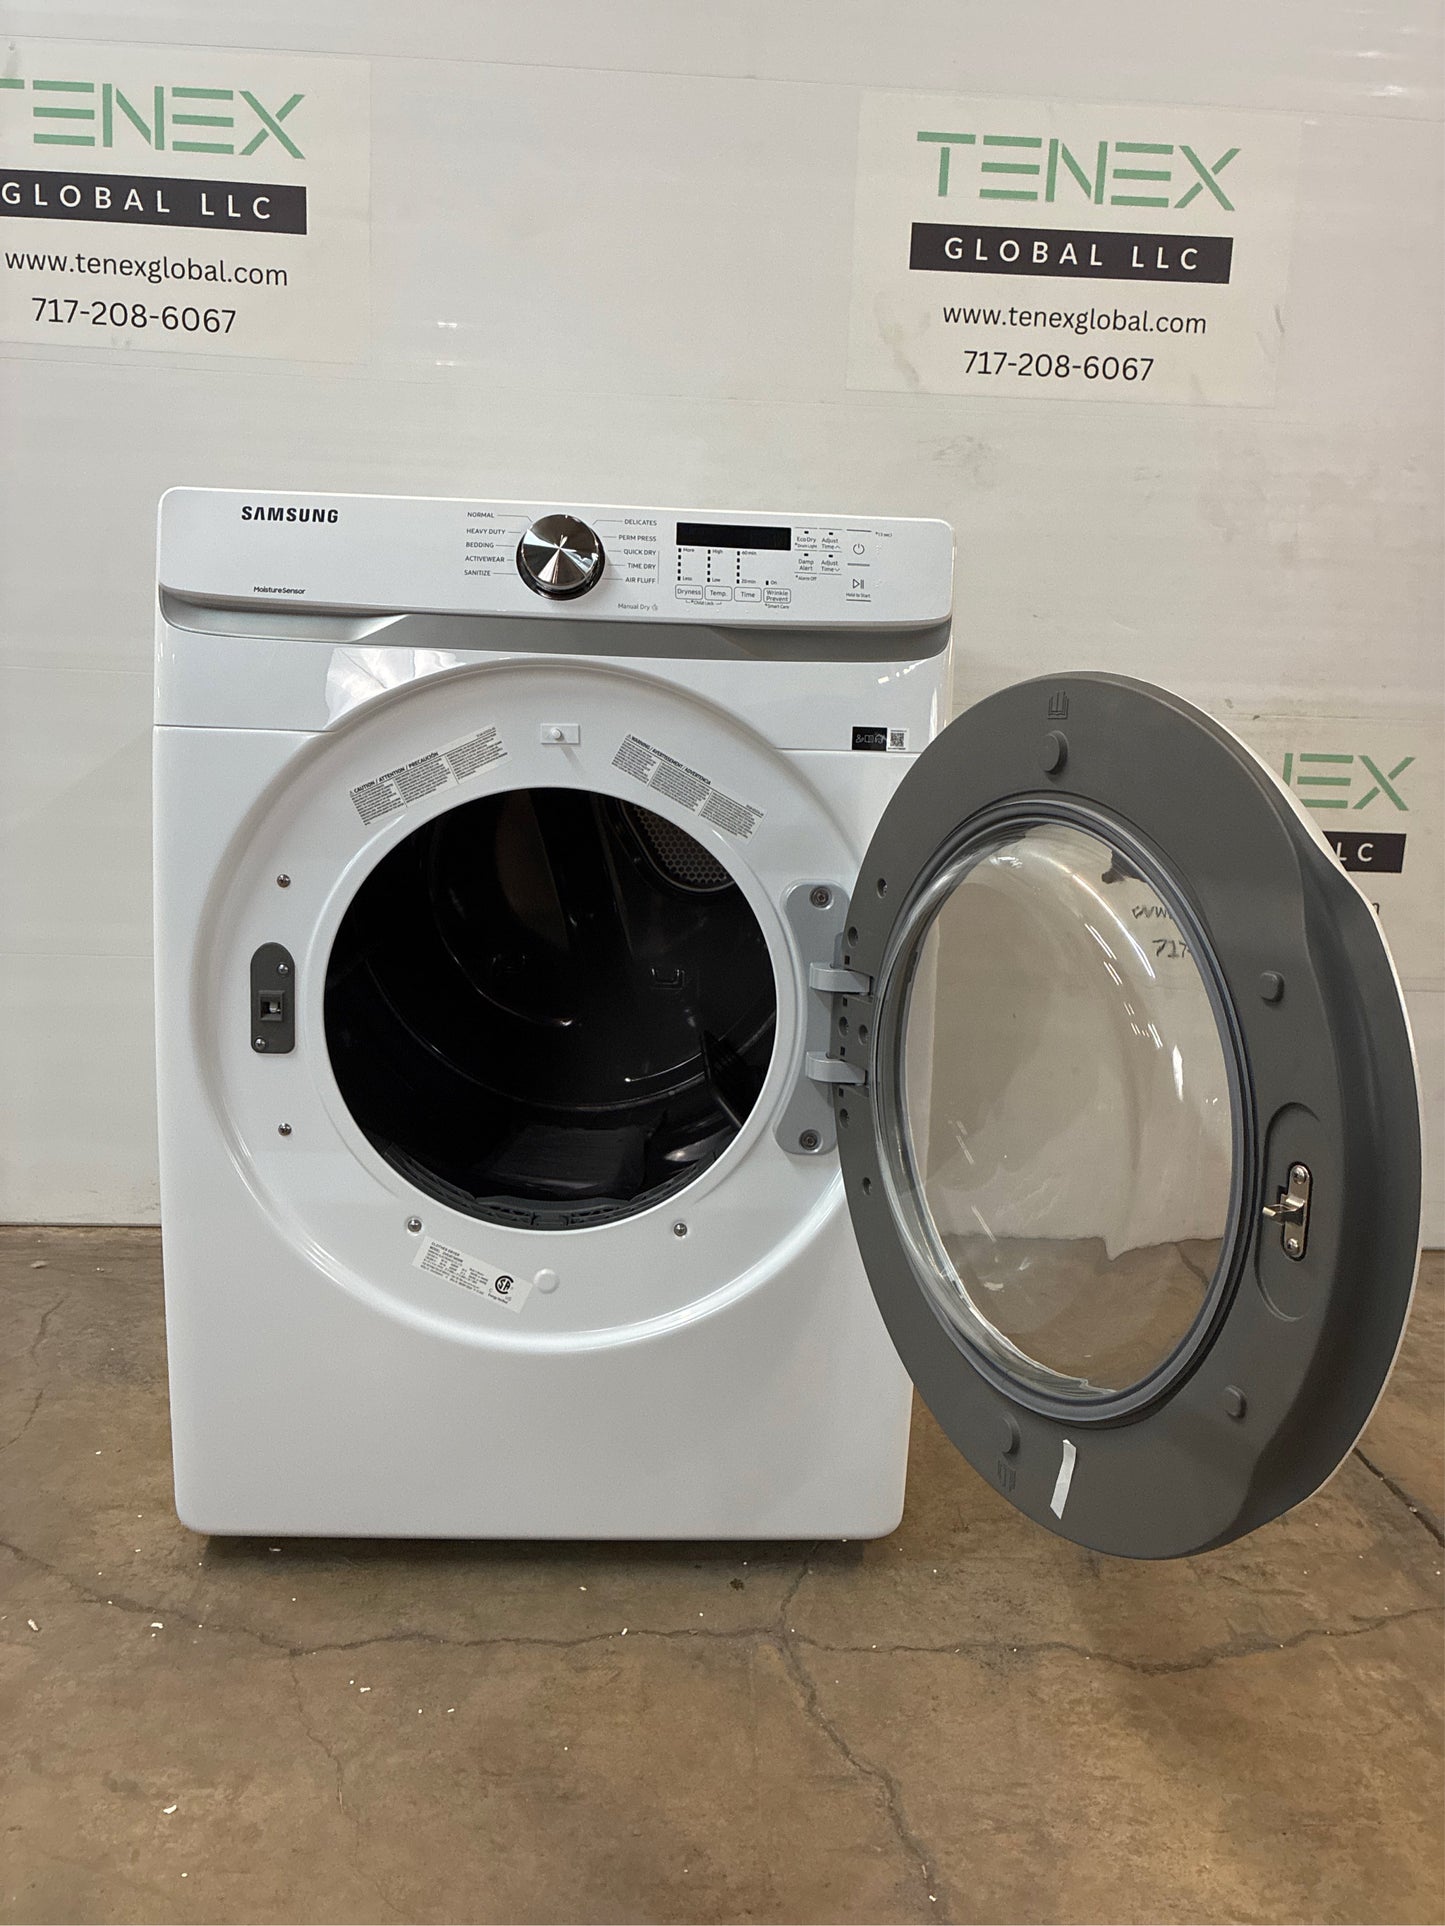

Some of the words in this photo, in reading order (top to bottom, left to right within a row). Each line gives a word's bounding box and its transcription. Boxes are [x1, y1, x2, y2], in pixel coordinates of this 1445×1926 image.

[917, 131, 1241, 212] TENEX
[1, 182, 170, 214] GLOBAL
[201, 193, 271, 220] LLC
[944, 237, 1103, 266] GLOBAL
[1131, 245, 1198, 270] LLC
[5, 252, 288, 286] www.tenexglobal.com
[31, 297, 236, 334] 717-208-6067
[943, 305, 1207, 335] www.tenexglobal.com
[963, 350, 1154, 382] 717-208-6067
[241, 505, 339, 524] SAMSUNG
[464, 555, 505, 563] ACTIVEWEAR
[798, 558, 814, 566] Damp
[821, 559, 838, 567] Adjust
[464, 569, 491, 577] SANITIZE
[637, 577, 656, 585] FLUFF
[677, 588, 701, 596] Dryness
[766, 595, 789, 603] Prevent
[640, 604, 650, 612] Dry
[631, 736, 650, 750] WARNING
[354, 780, 375, 793] CAUTION
[379, 767, 405, 782] ATTENTION
